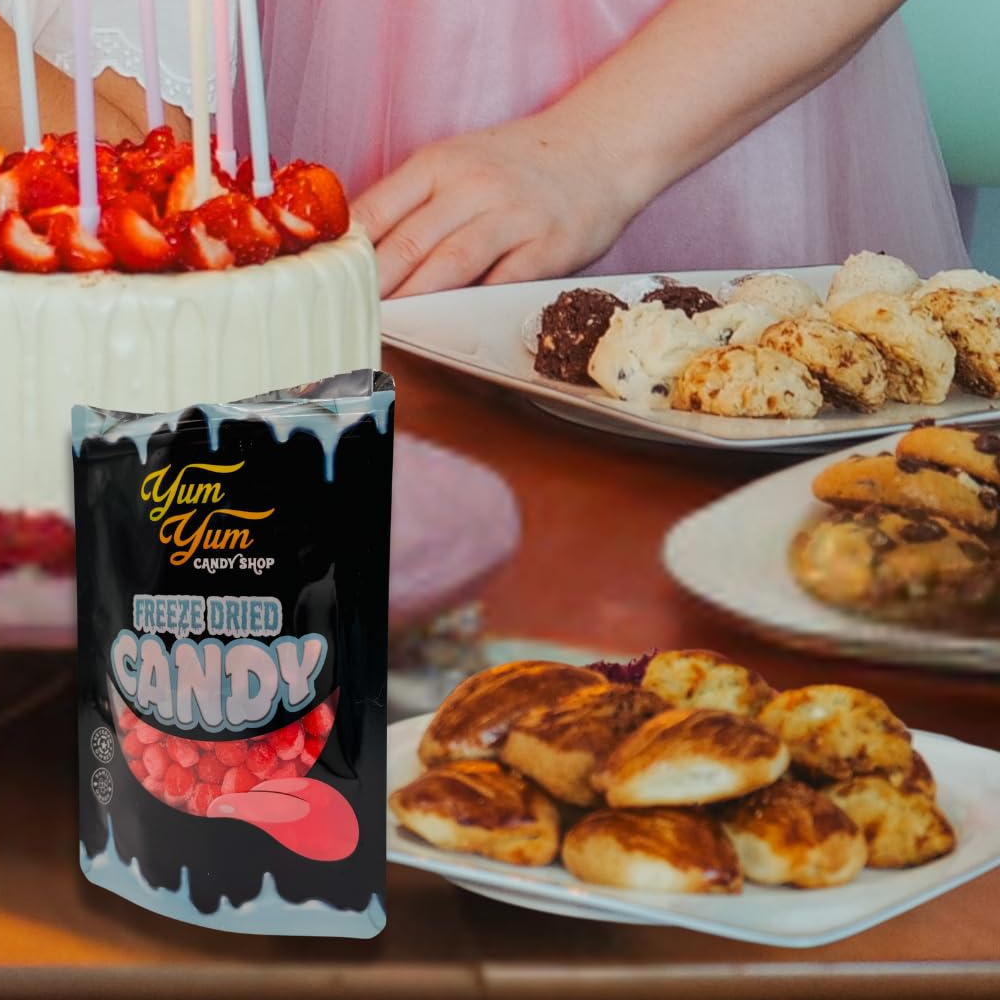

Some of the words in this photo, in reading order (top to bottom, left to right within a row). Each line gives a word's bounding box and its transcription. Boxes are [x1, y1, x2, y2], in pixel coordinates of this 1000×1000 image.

[140, 460, 246, 522] Yum
[159, 507, 276, 566] Yum
[193, 553, 243, 575] CANDY
[238, 557, 275, 575] SHOP
[133, 594, 206, 639] FREEZE
[206, 595, 283, 637] DRIED
[110, 629, 328, 733] CANDY
